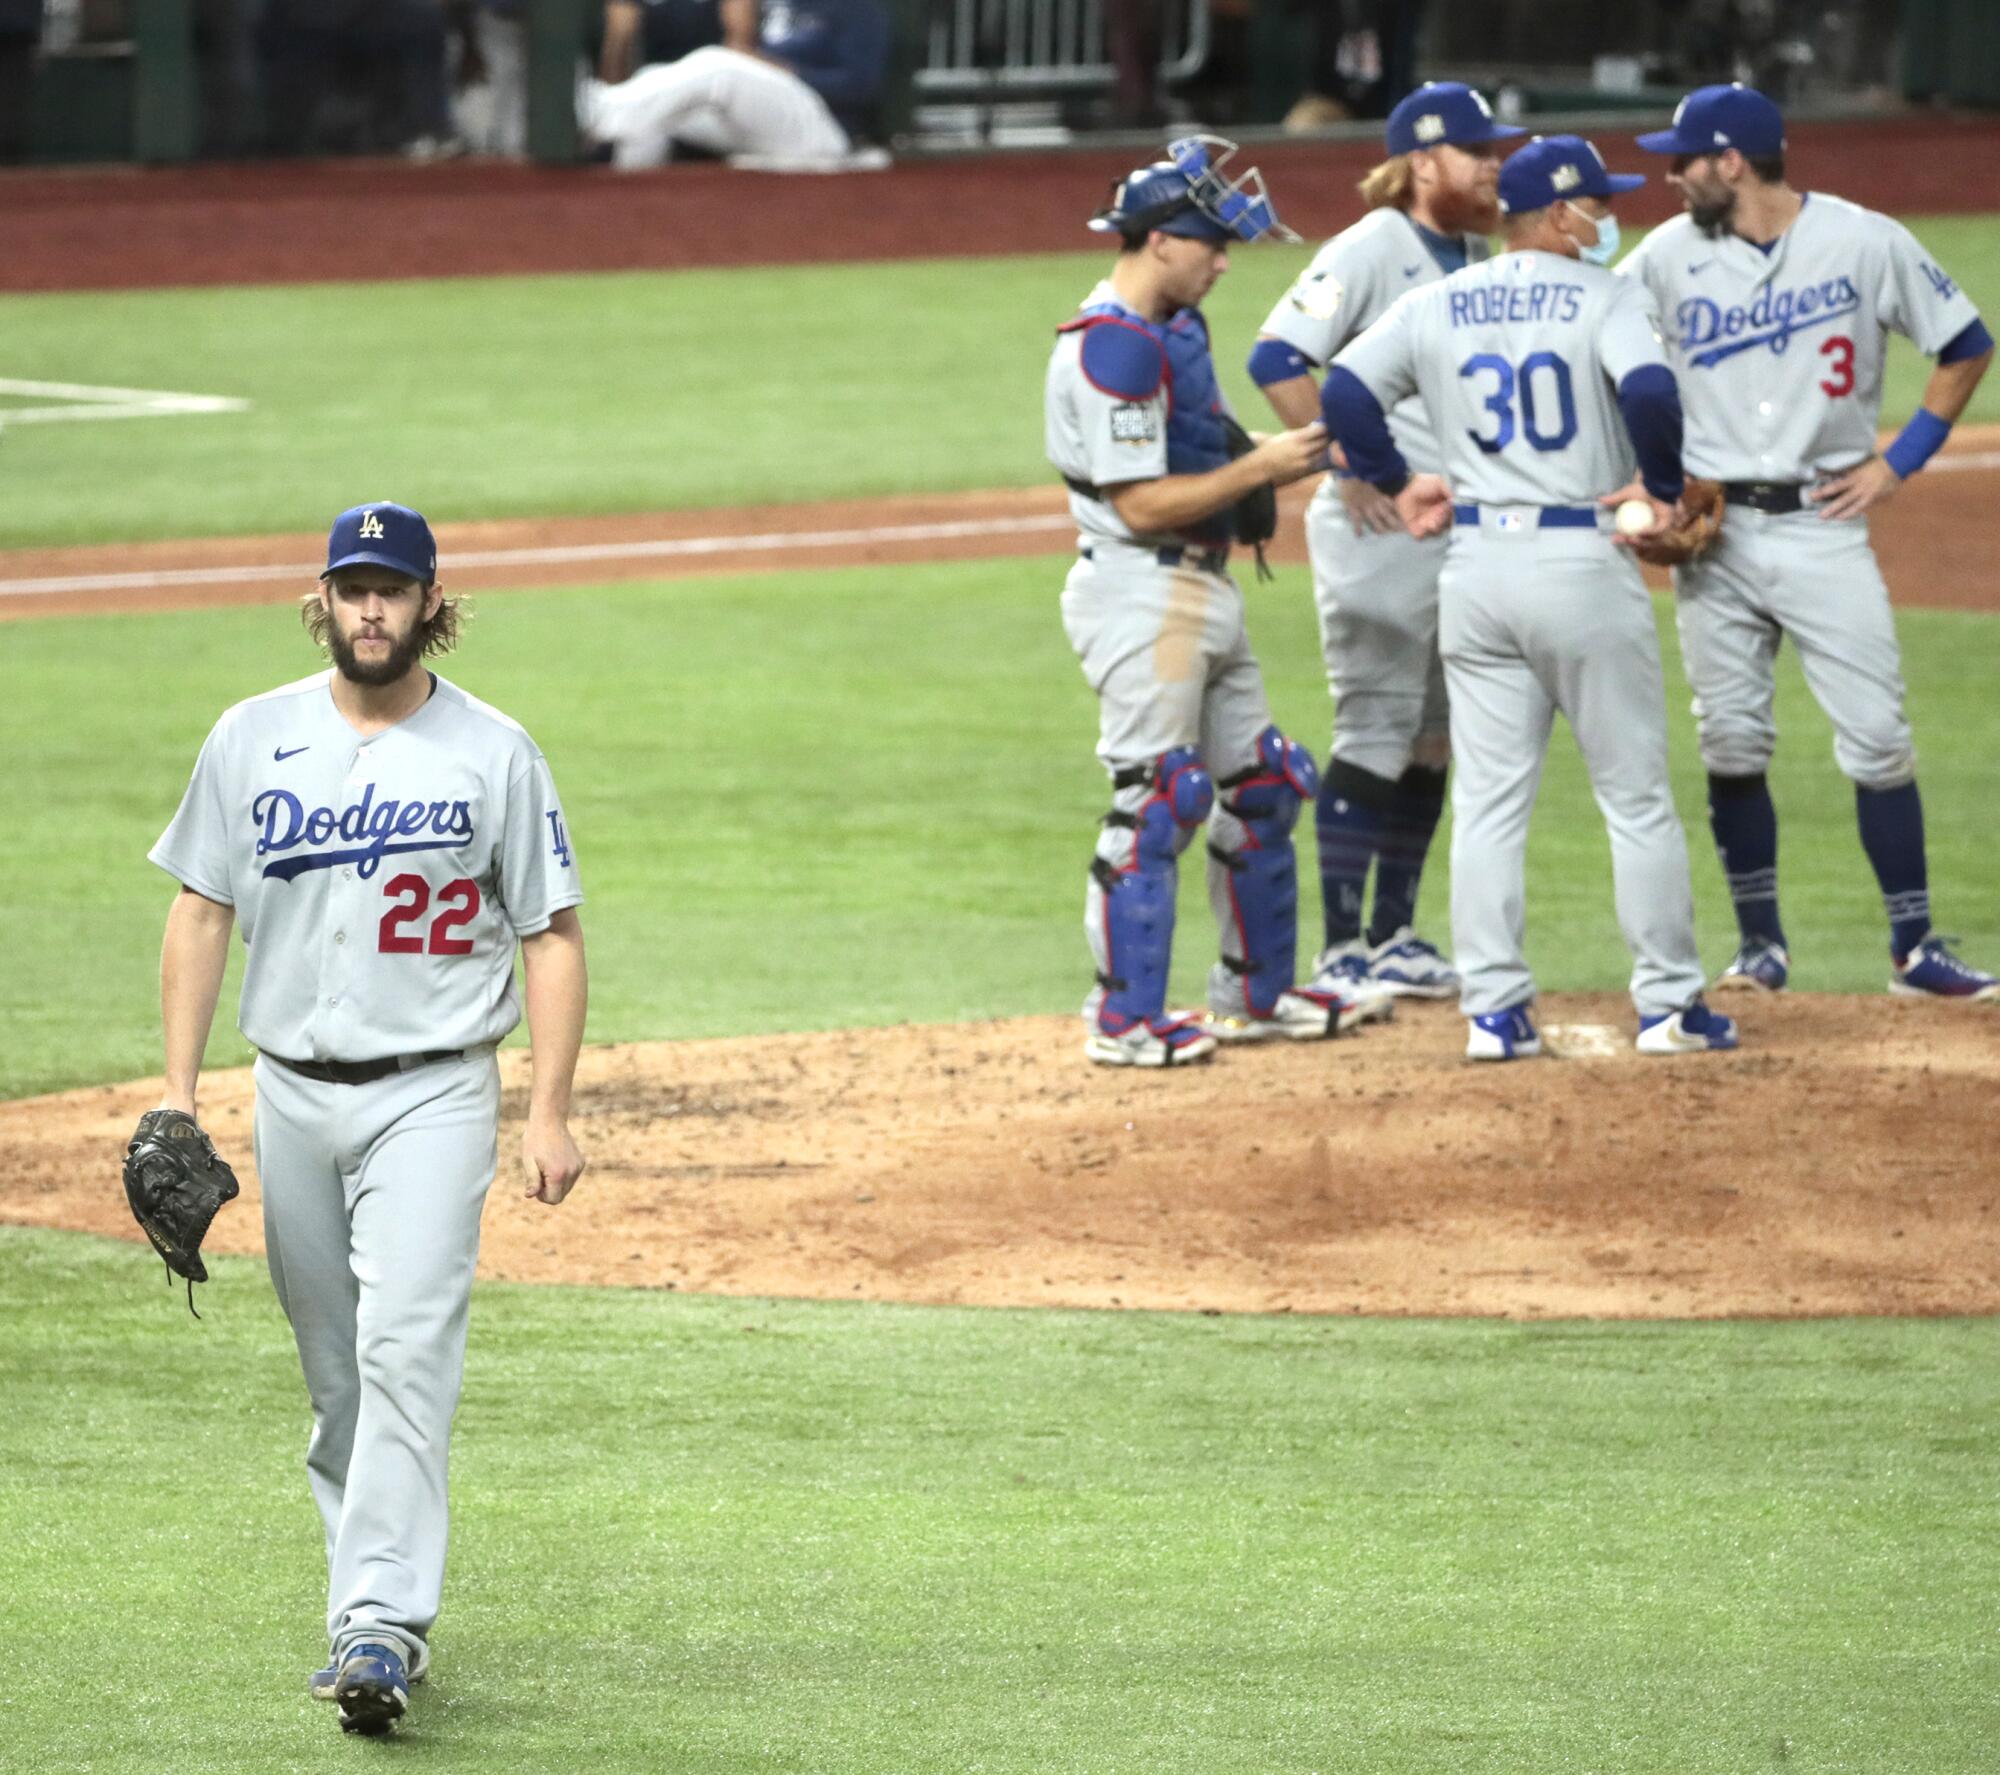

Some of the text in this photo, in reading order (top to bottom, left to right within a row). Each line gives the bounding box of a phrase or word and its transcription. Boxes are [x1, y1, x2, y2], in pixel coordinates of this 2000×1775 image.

[1449, 283, 1584, 328] ROBERTS
[1677, 275, 1859, 356] Dodgers
[1459, 352, 1578, 453] 30
[1819, 336, 1856, 398] 3
[358, 510, 384, 539] LA
[252, 783, 474, 880] Dodgers
[378, 873, 480, 955] 22
